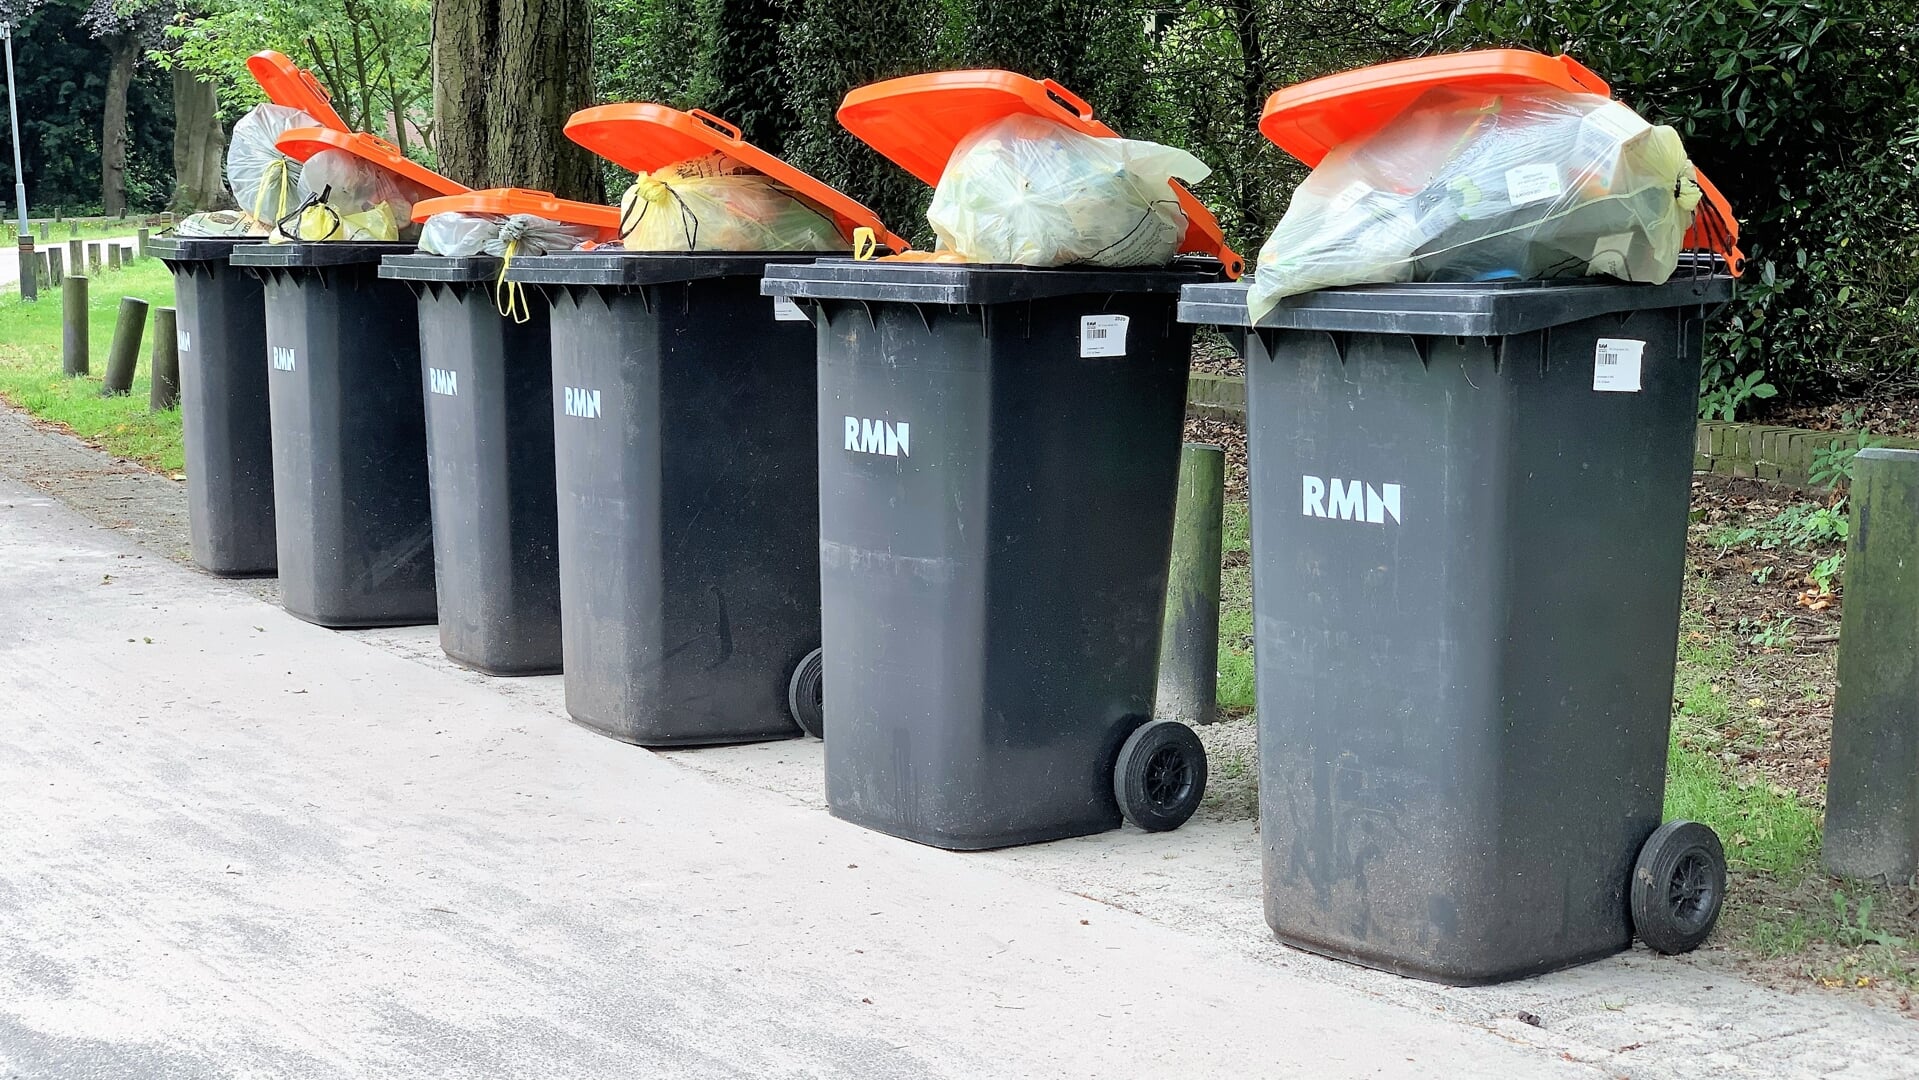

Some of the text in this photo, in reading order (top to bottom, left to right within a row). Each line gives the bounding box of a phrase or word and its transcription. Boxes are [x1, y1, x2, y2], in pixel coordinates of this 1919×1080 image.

[177, 330, 190, 352] MN
[273, 346, 296, 372] RMN
[430, 367, 458, 396] RMN
[565, 386, 601, 419] RMN
[844, 416, 910, 457] RMN
[1302, 475, 1401, 525] RMN
